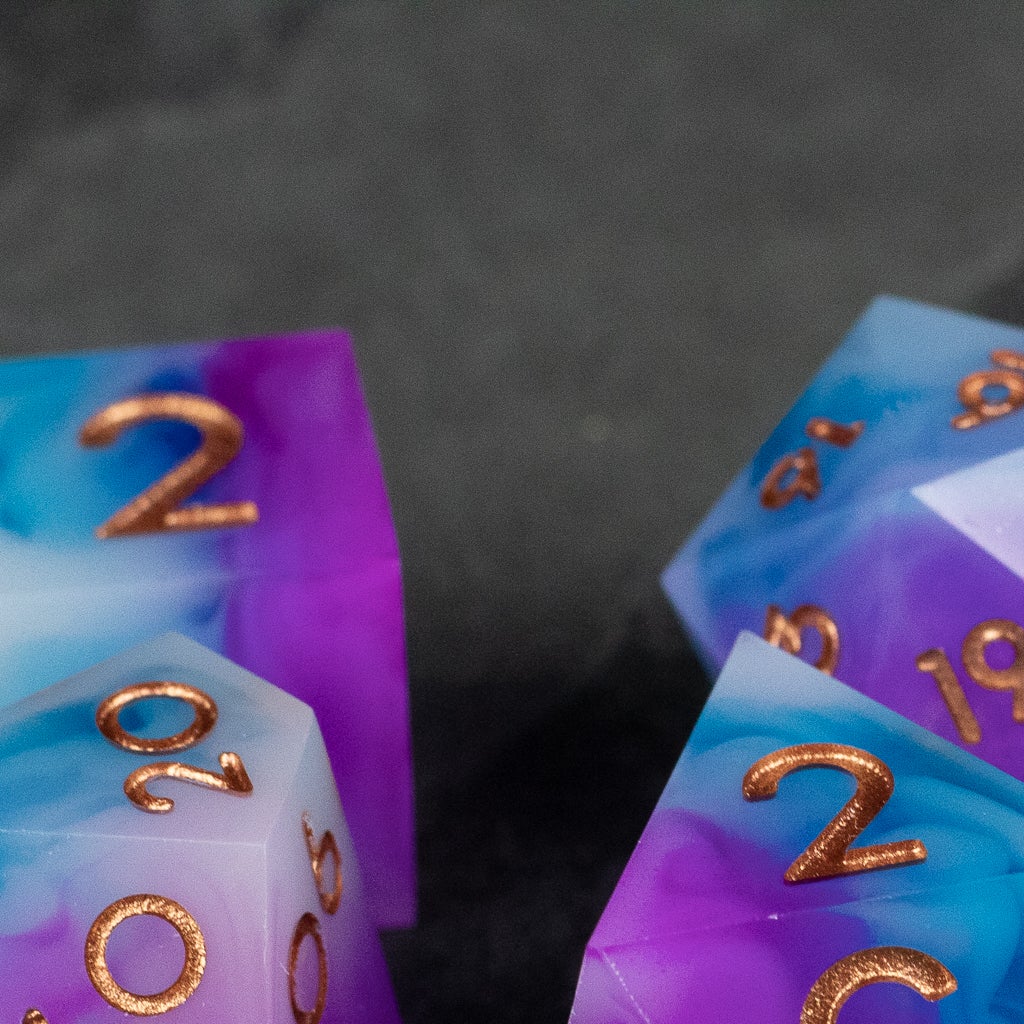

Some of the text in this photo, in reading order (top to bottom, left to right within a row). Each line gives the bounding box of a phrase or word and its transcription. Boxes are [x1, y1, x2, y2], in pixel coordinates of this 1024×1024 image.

[78, 391, 259, 540] 2
[94, 680, 254, 815] 20
[741, 742, 929, 886] 2
